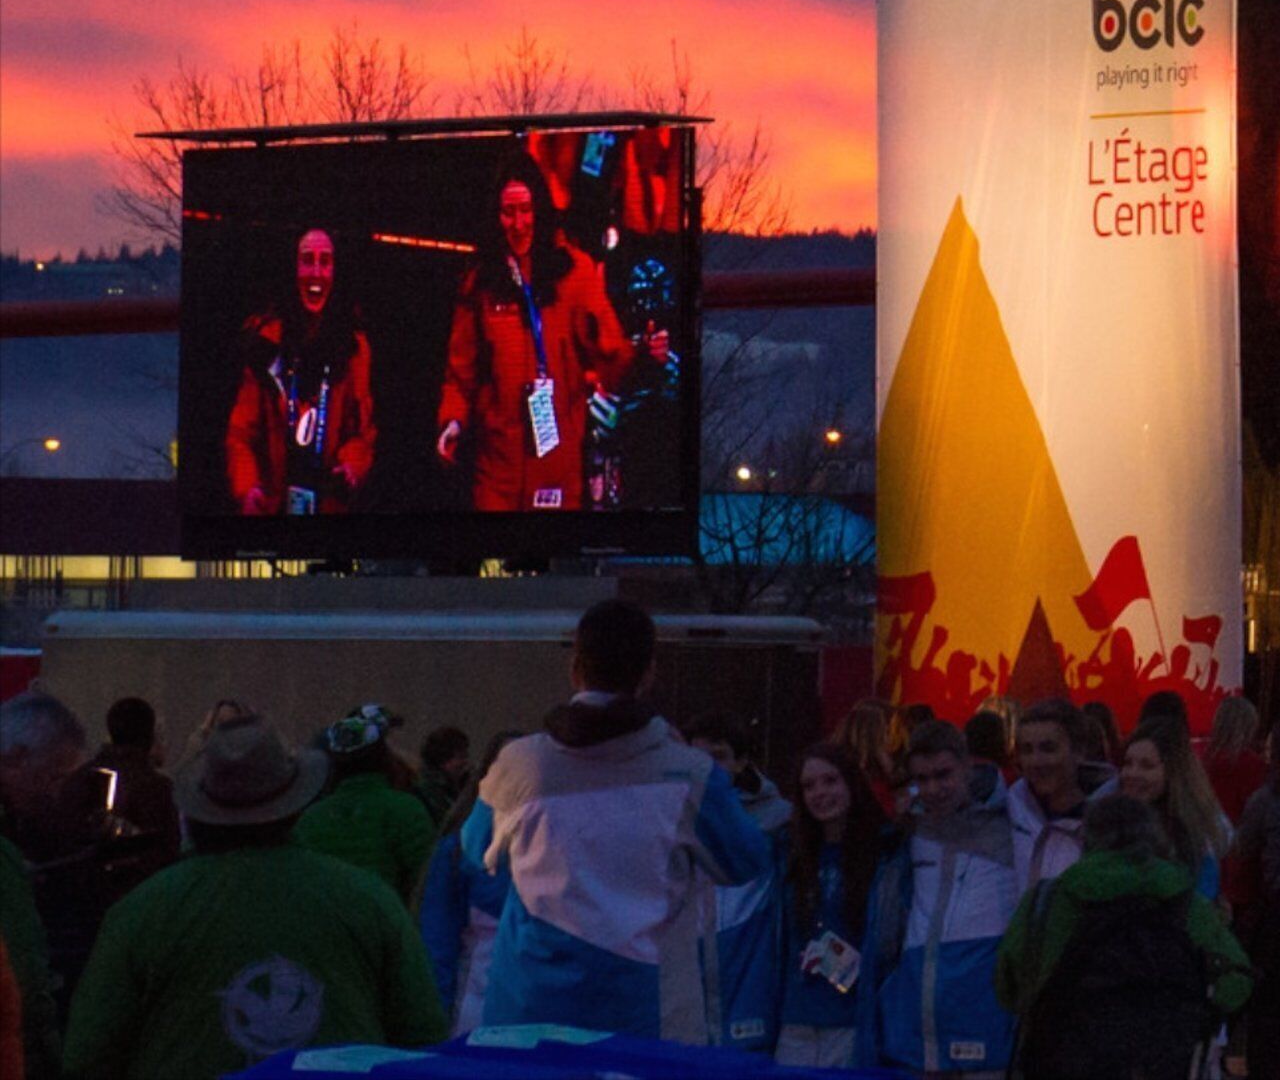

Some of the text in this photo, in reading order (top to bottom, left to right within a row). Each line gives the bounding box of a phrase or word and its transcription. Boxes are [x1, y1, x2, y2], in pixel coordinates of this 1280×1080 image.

[1096, 63, 1199, 91] playing it right
[1088, 128, 1208, 193] L'Étage
[1092, 191, 1206, 239] Centre
